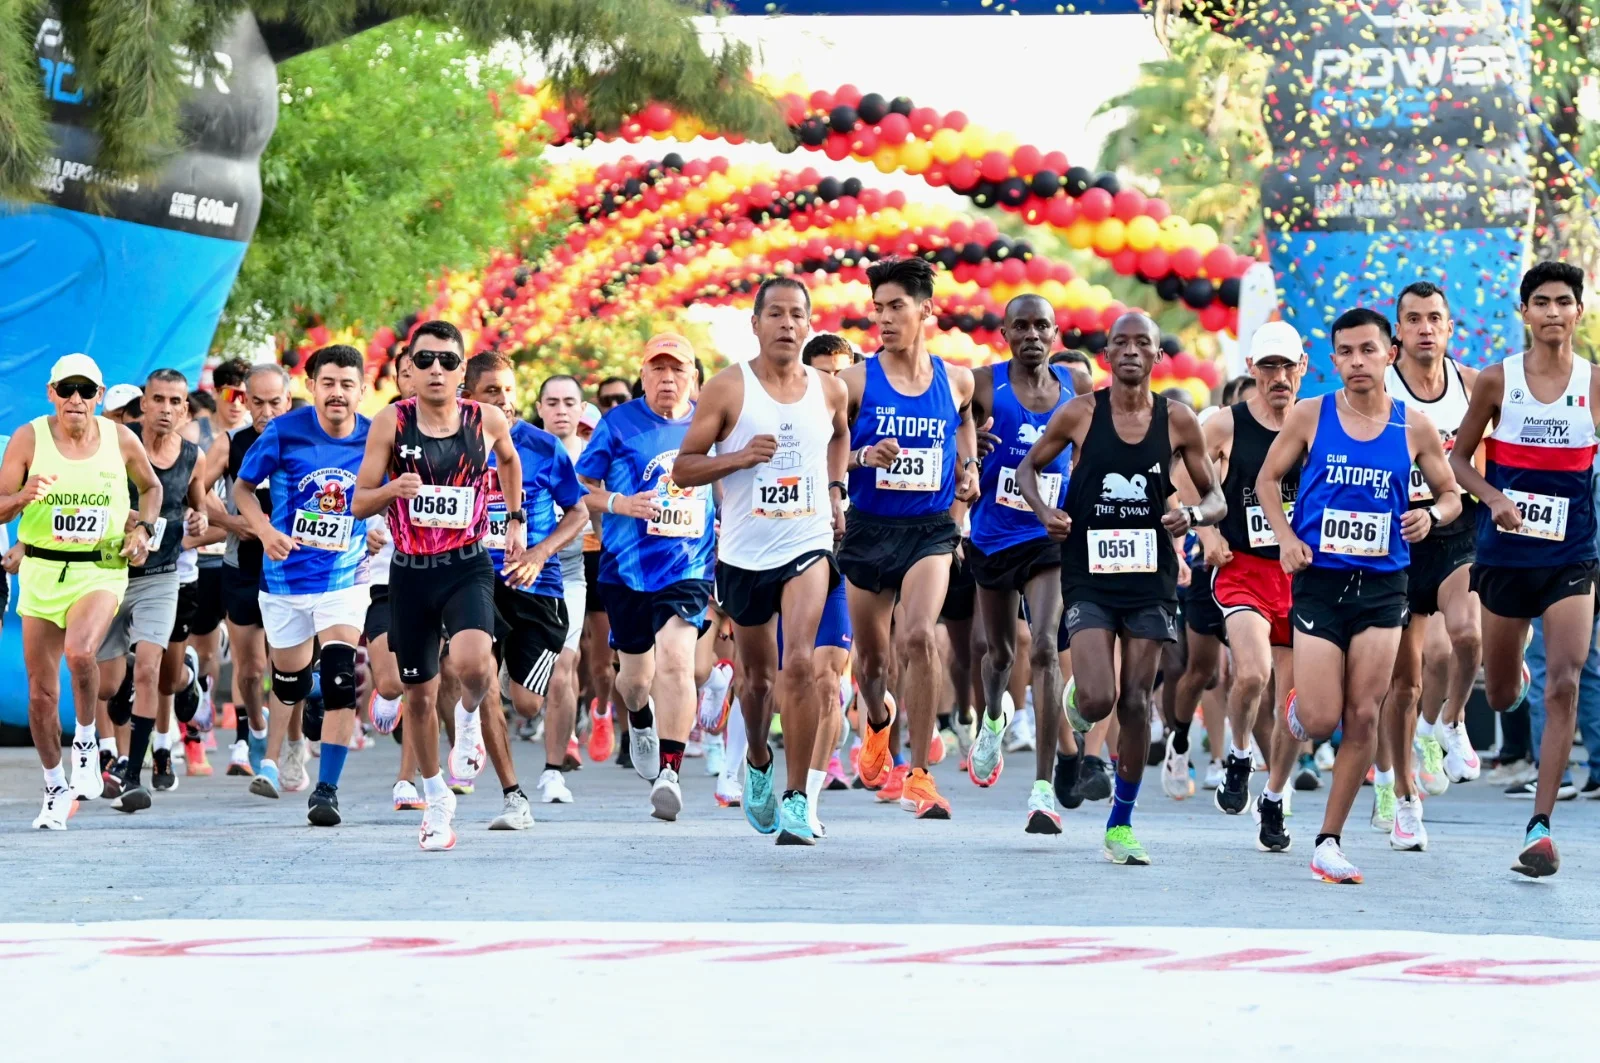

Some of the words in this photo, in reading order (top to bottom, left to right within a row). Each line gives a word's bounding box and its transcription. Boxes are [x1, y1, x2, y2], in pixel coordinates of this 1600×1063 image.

[1313, 46, 1513, 87] POWER
[876, 406, 896, 415] CLUB
[875, 415, 947, 440] ZATOPEK
[1523, 416, 1568, 426] Marathon
[1520, 436, 1547, 444] TRACK
[1552, 426, 1569, 437] TV
[1009, 446, 1028, 456] THE
[1326, 454, 1348, 463] CLUB
[299, 475, 312, 490] GRAN
[312, 468, 342, 478] CARRERA
[644, 460, 657, 480] GRAN
[1325, 465, 1393, 489] ZATOPEK
[760, 485, 799, 504] 1234
[1374, 488, 1389, 500] ZAC
[413, 495, 458, 516] 0583
[1094, 504, 1115, 516] THE
[1119, 506, 1151, 518] SWAN
[1516, 501, 1553, 524] 364
[54, 514, 97, 532] 0022
[296, 518, 339, 538] 0432
[1323, 518, 1378, 542] 0036
[392, 546, 452, 569] OUR
[1098, 539, 1136, 559] 0551
